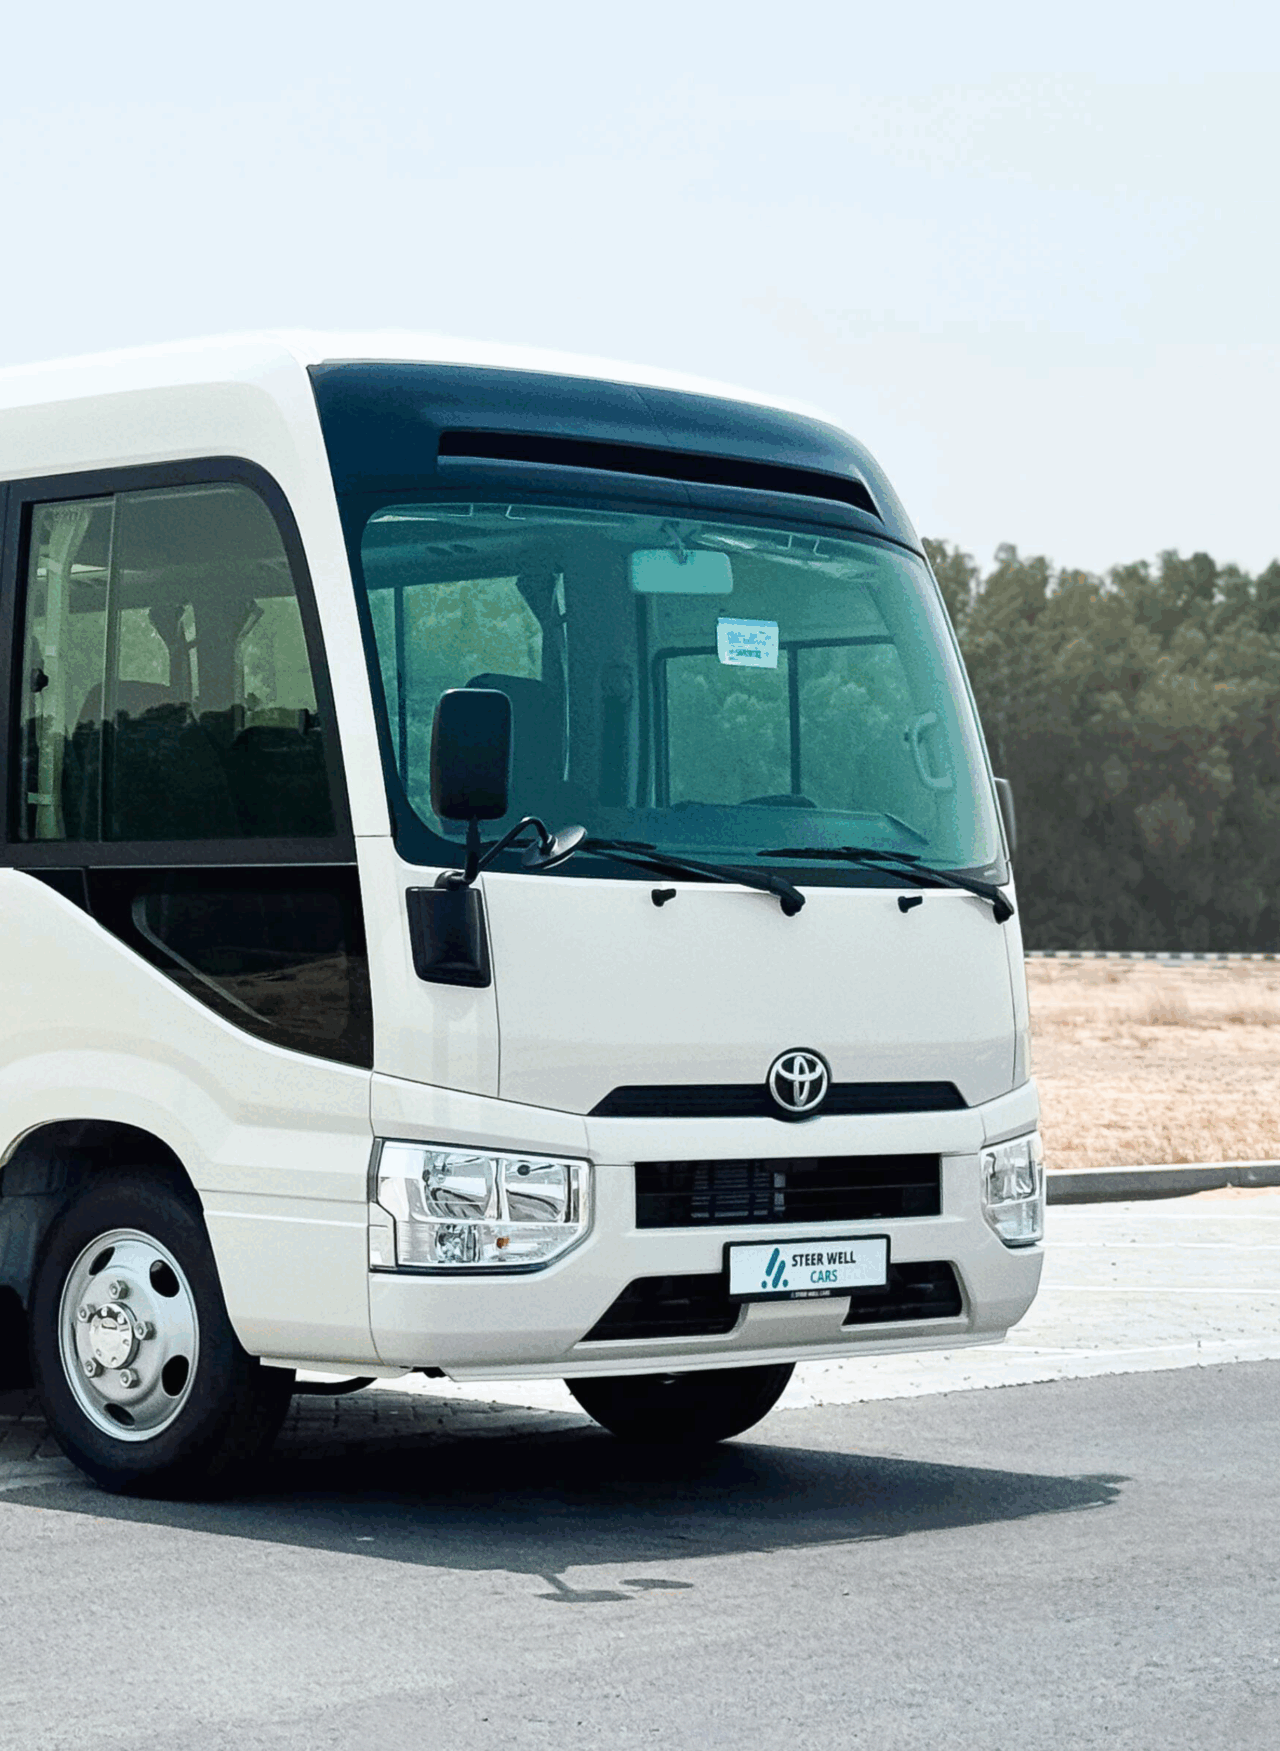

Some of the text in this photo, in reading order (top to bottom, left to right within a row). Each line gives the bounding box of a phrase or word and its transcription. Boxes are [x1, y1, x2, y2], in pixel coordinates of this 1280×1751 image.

[792, 1251, 856, 1267] STEER WELL
[810, 1269, 838, 1283] CARS
